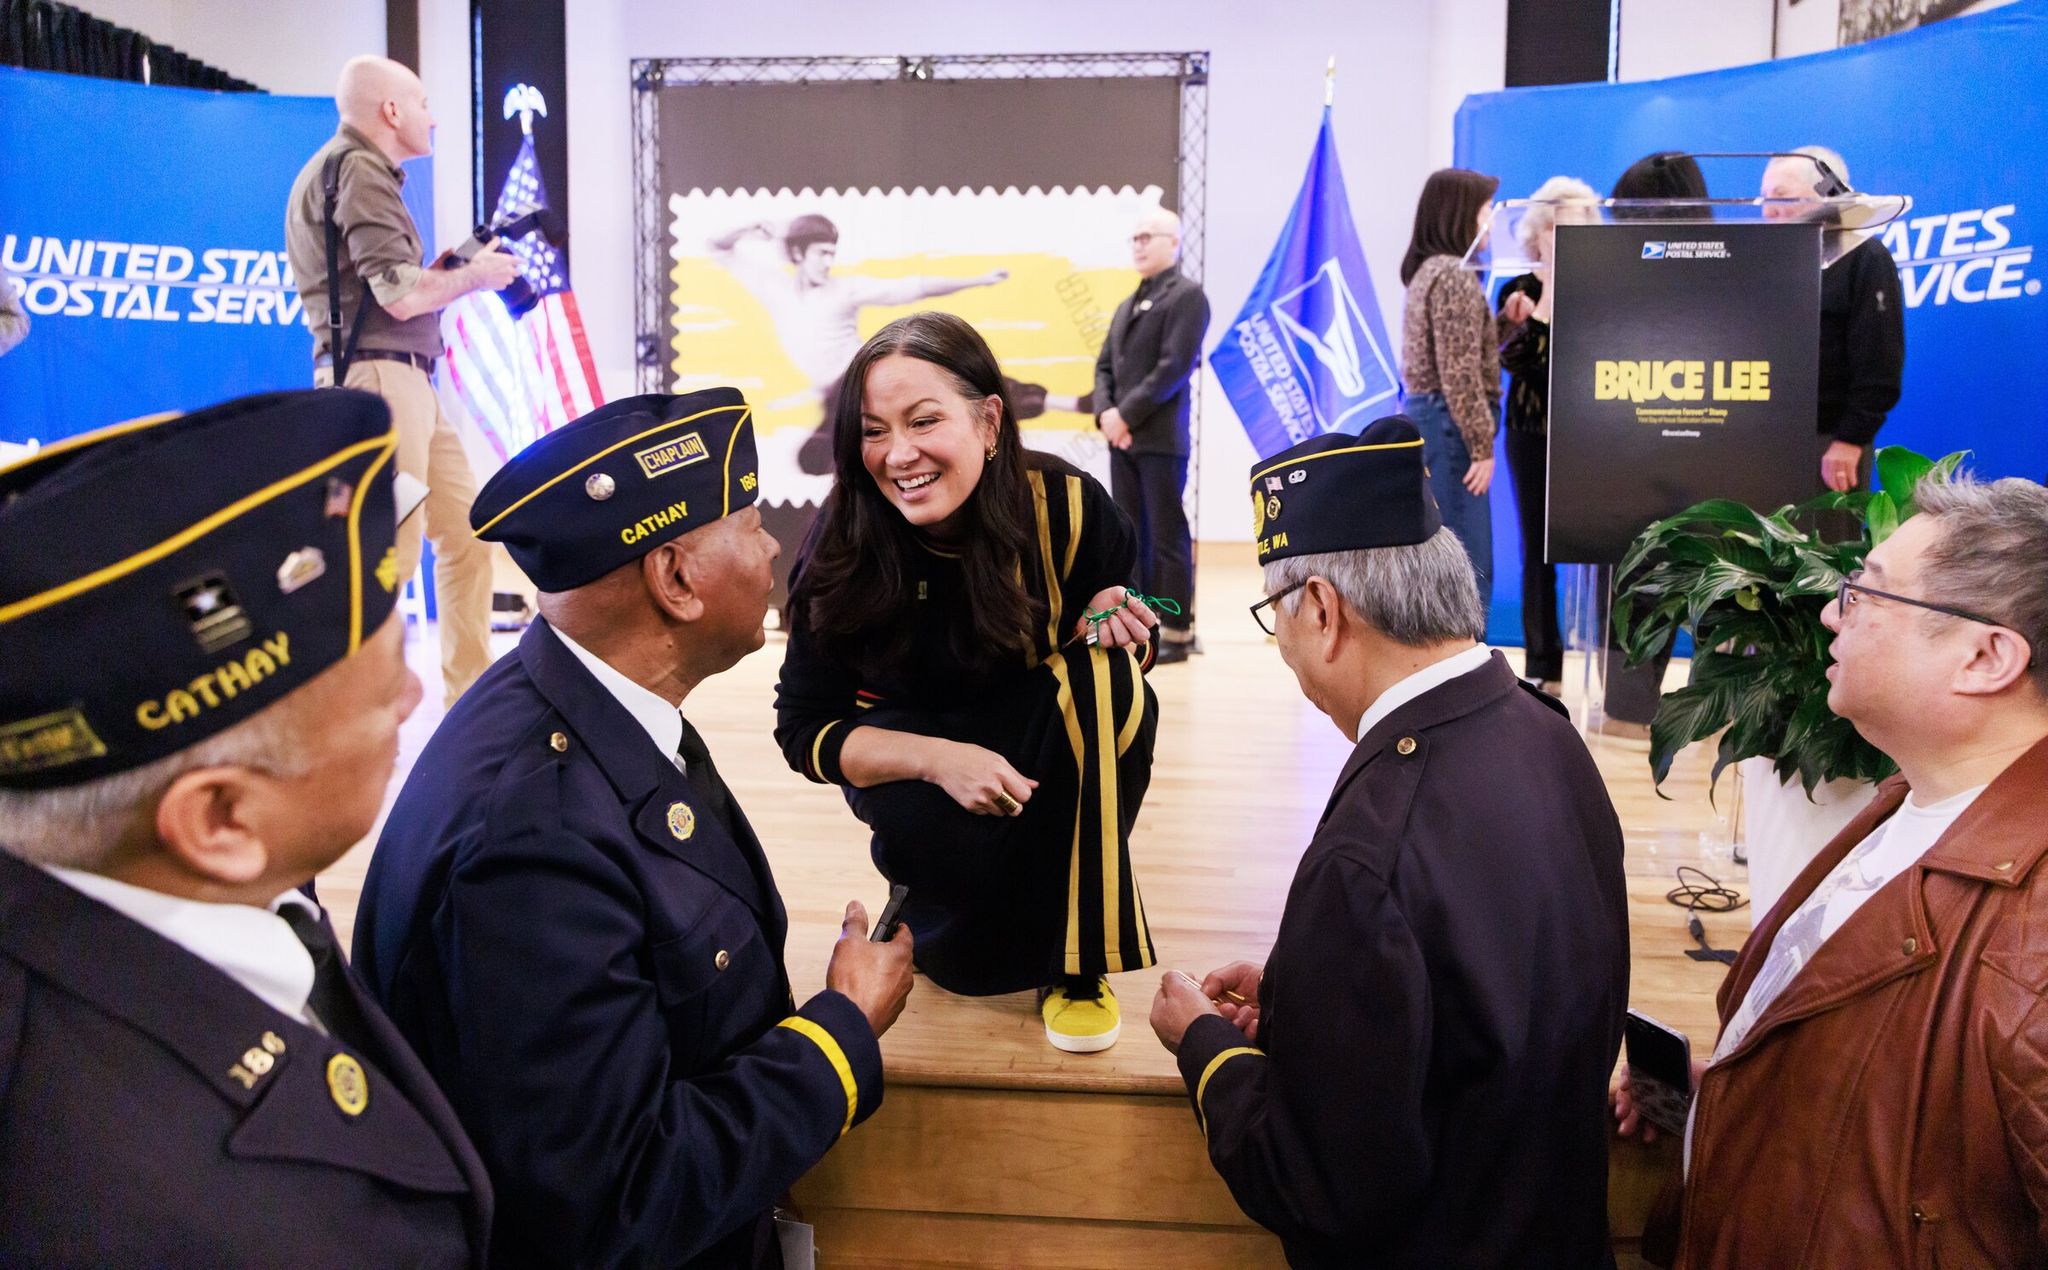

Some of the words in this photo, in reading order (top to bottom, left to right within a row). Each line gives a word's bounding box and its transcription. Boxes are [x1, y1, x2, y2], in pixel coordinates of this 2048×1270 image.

[1664, 249, 1693, 259] POSTAL
[1667, 241, 1697, 250] UNITED
[1697, 241, 1725, 250] STATES
[1875, 204, 2016, 262] ATES
[2, 234, 194, 282] UNITED
[1899, 252, 2033, 308] VICE
[188, 288, 310, 326] SERV
[1250, 311, 1292, 379] UNITED
[1594, 360, 1706, 403] BRUCE
[1713, 360, 1771, 401] LEE
[643, 438, 702, 470] CHAPLAIN
[740, 472, 757, 492] 186
[621, 501, 688, 545] CATHAY
[1272, 532, 1289, 550] WA
[136, 631, 291, 730] CATHAY
